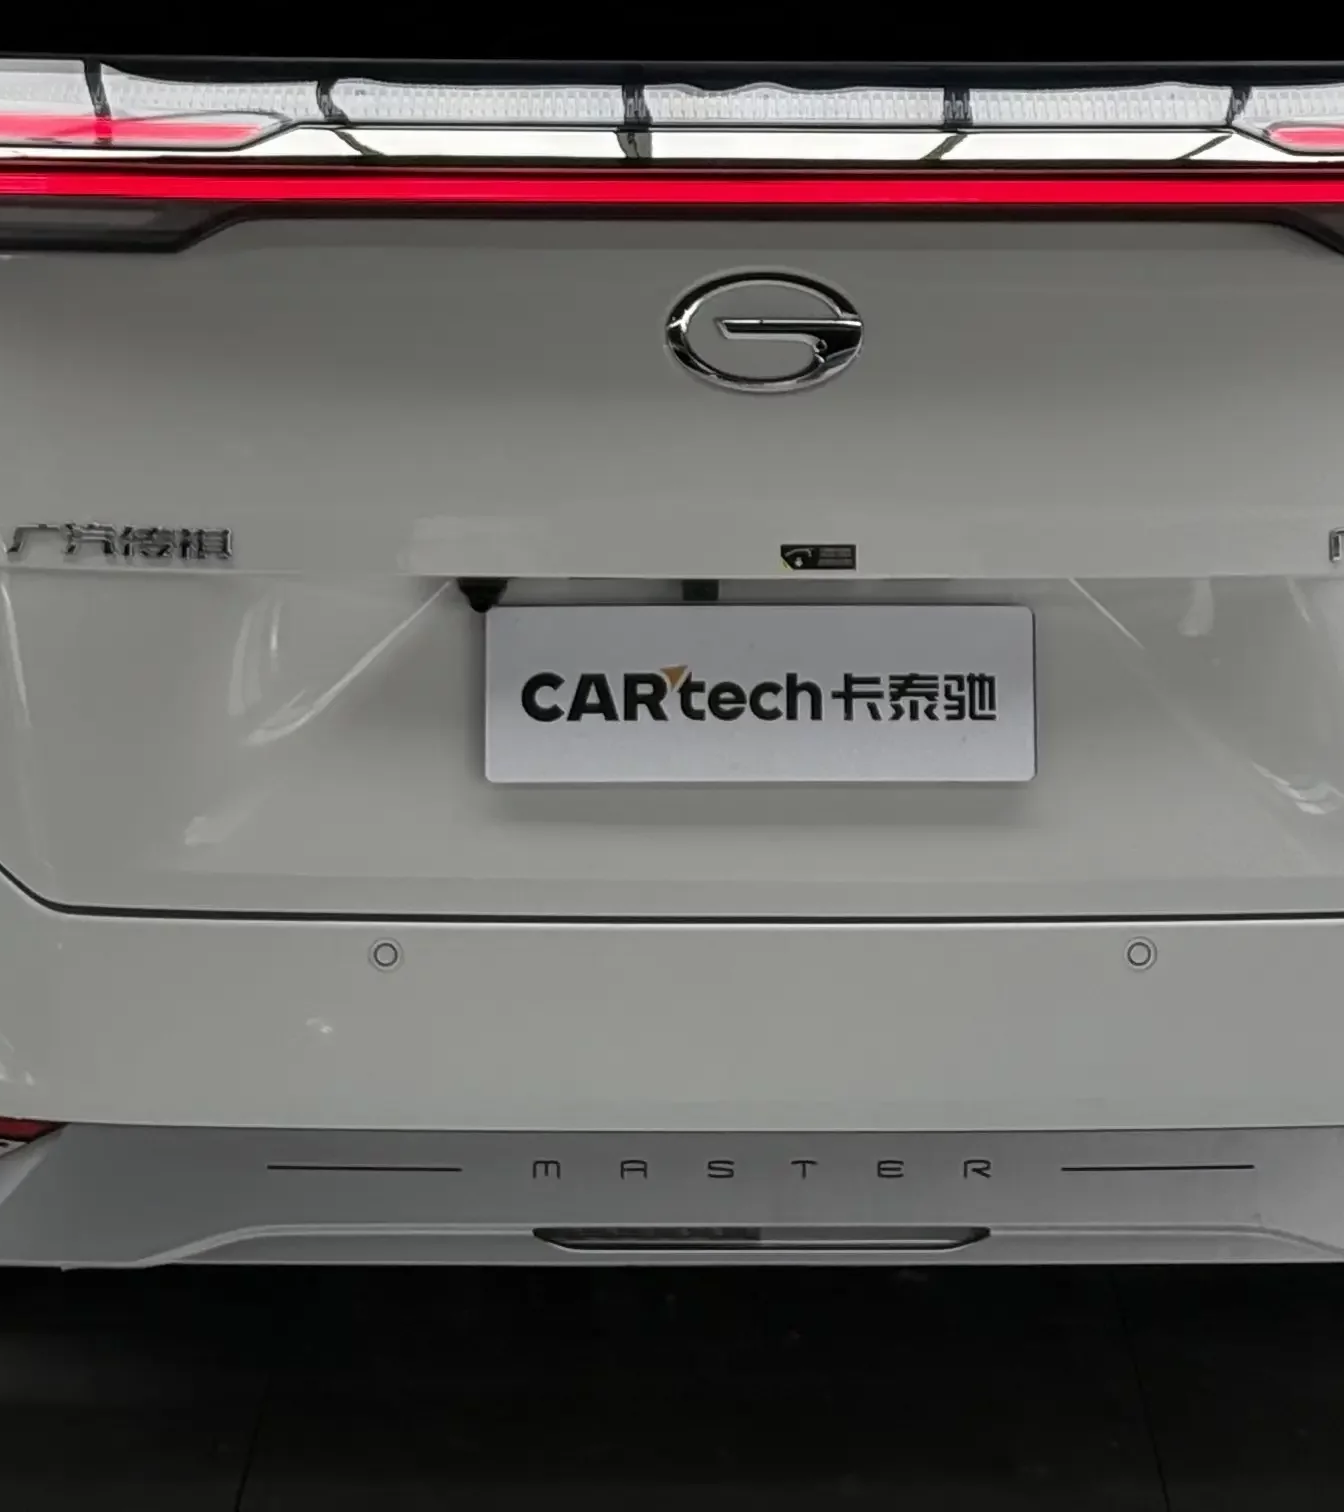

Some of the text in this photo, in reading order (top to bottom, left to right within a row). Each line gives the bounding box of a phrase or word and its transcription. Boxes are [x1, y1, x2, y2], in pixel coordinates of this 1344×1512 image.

[520, 665, 997, 723] CARtech 卡泰驰
[531, 1159, 994, 1179] MASTER
